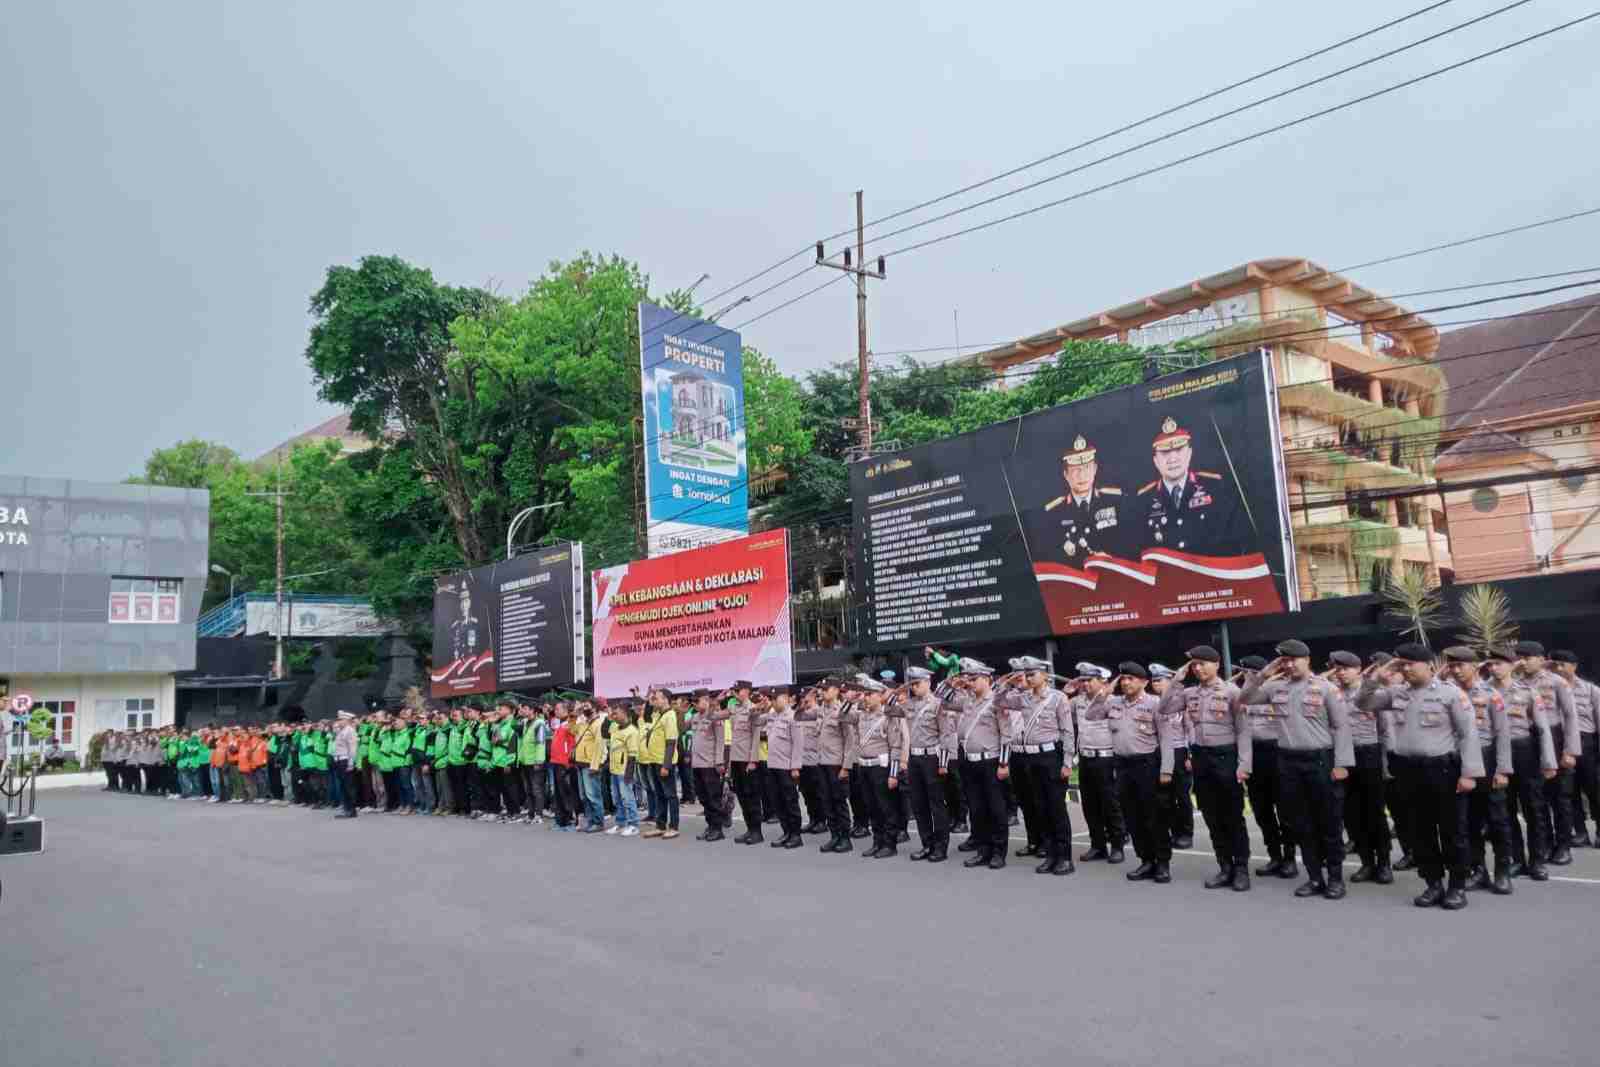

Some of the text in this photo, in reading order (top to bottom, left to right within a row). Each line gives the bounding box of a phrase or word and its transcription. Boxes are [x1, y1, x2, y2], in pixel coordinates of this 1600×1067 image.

[664, 345, 725, 374] PROPERTI
[629, 580, 693, 603] KEBANGSAAN
[695, 578, 703, 591] &
[704, 567, 763, 588] DEKLARASI
[685, 598, 719, 614] ONLINE
[601, 625, 775, 657] KAMTIBMAS YANG KONDUSIF DI KOTA MALANG
[634, 618, 731, 641] GUNA MEMPERTAHANKAN
